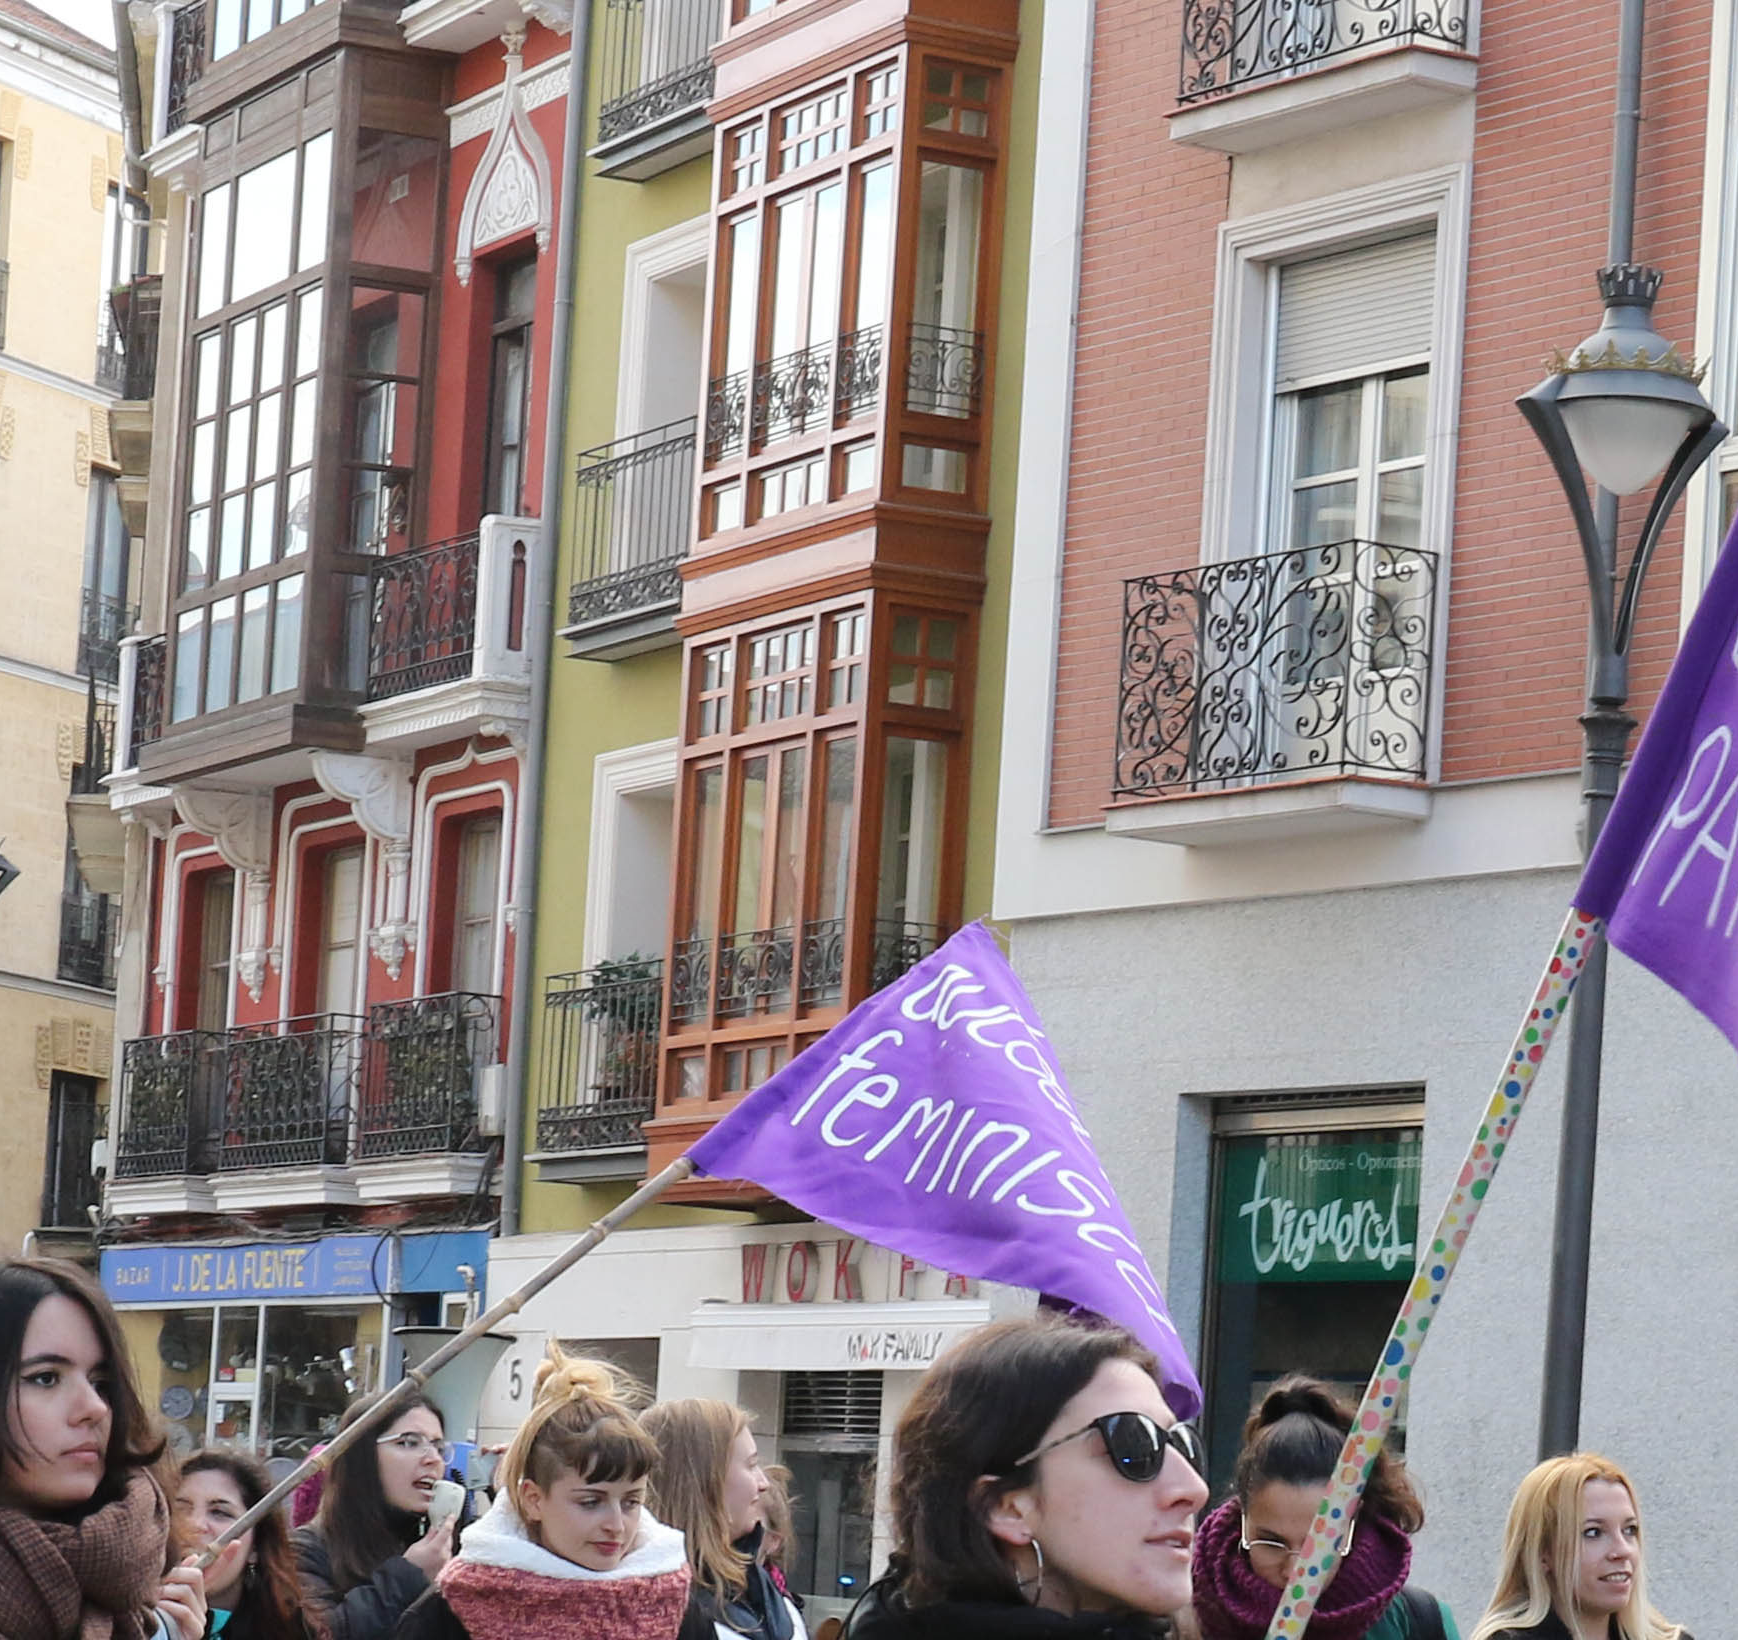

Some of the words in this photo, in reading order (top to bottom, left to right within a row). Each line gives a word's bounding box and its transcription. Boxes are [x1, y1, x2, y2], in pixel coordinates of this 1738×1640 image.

[116, 1265, 150, 1286] BAZAR
[172, 1254, 186, 1293] J.
[190, 1253, 213, 1292] DE
[215, 1252, 237, 1291] LA
[242, 1247, 307, 1289] FUENTE
[742, 1239, 855, 1303] WOK
[883, 1332, 943, 1360] FAMILY
[510, 1359, 522, 1401] 5
